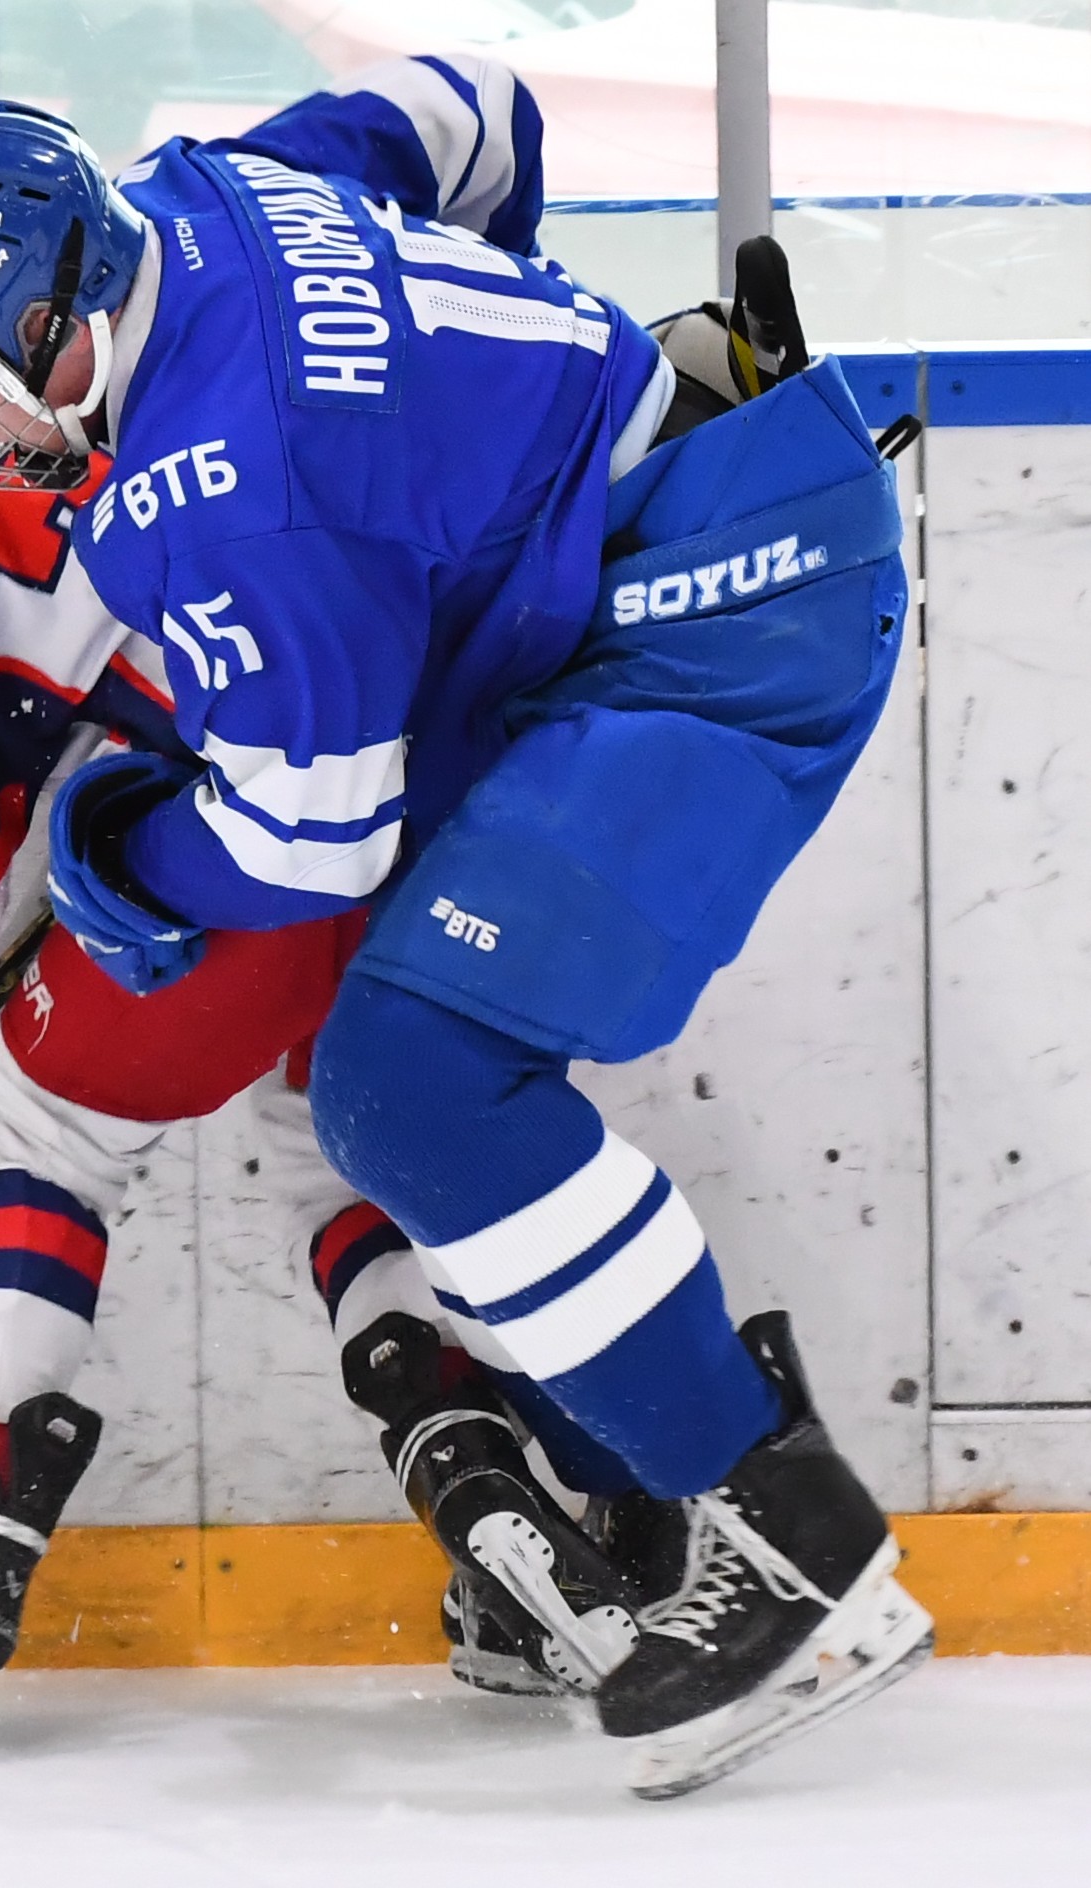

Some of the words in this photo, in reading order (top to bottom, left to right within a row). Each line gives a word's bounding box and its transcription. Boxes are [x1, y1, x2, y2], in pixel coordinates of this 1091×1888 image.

[174, 217, 203, 271] LUTCH
[122, 440, 238, 530] ВТБ
[613, 534, 802, 626] SOYUZ
[163, 591, 263, 690] 15
[445, 909, 500, 951] ВТБ
